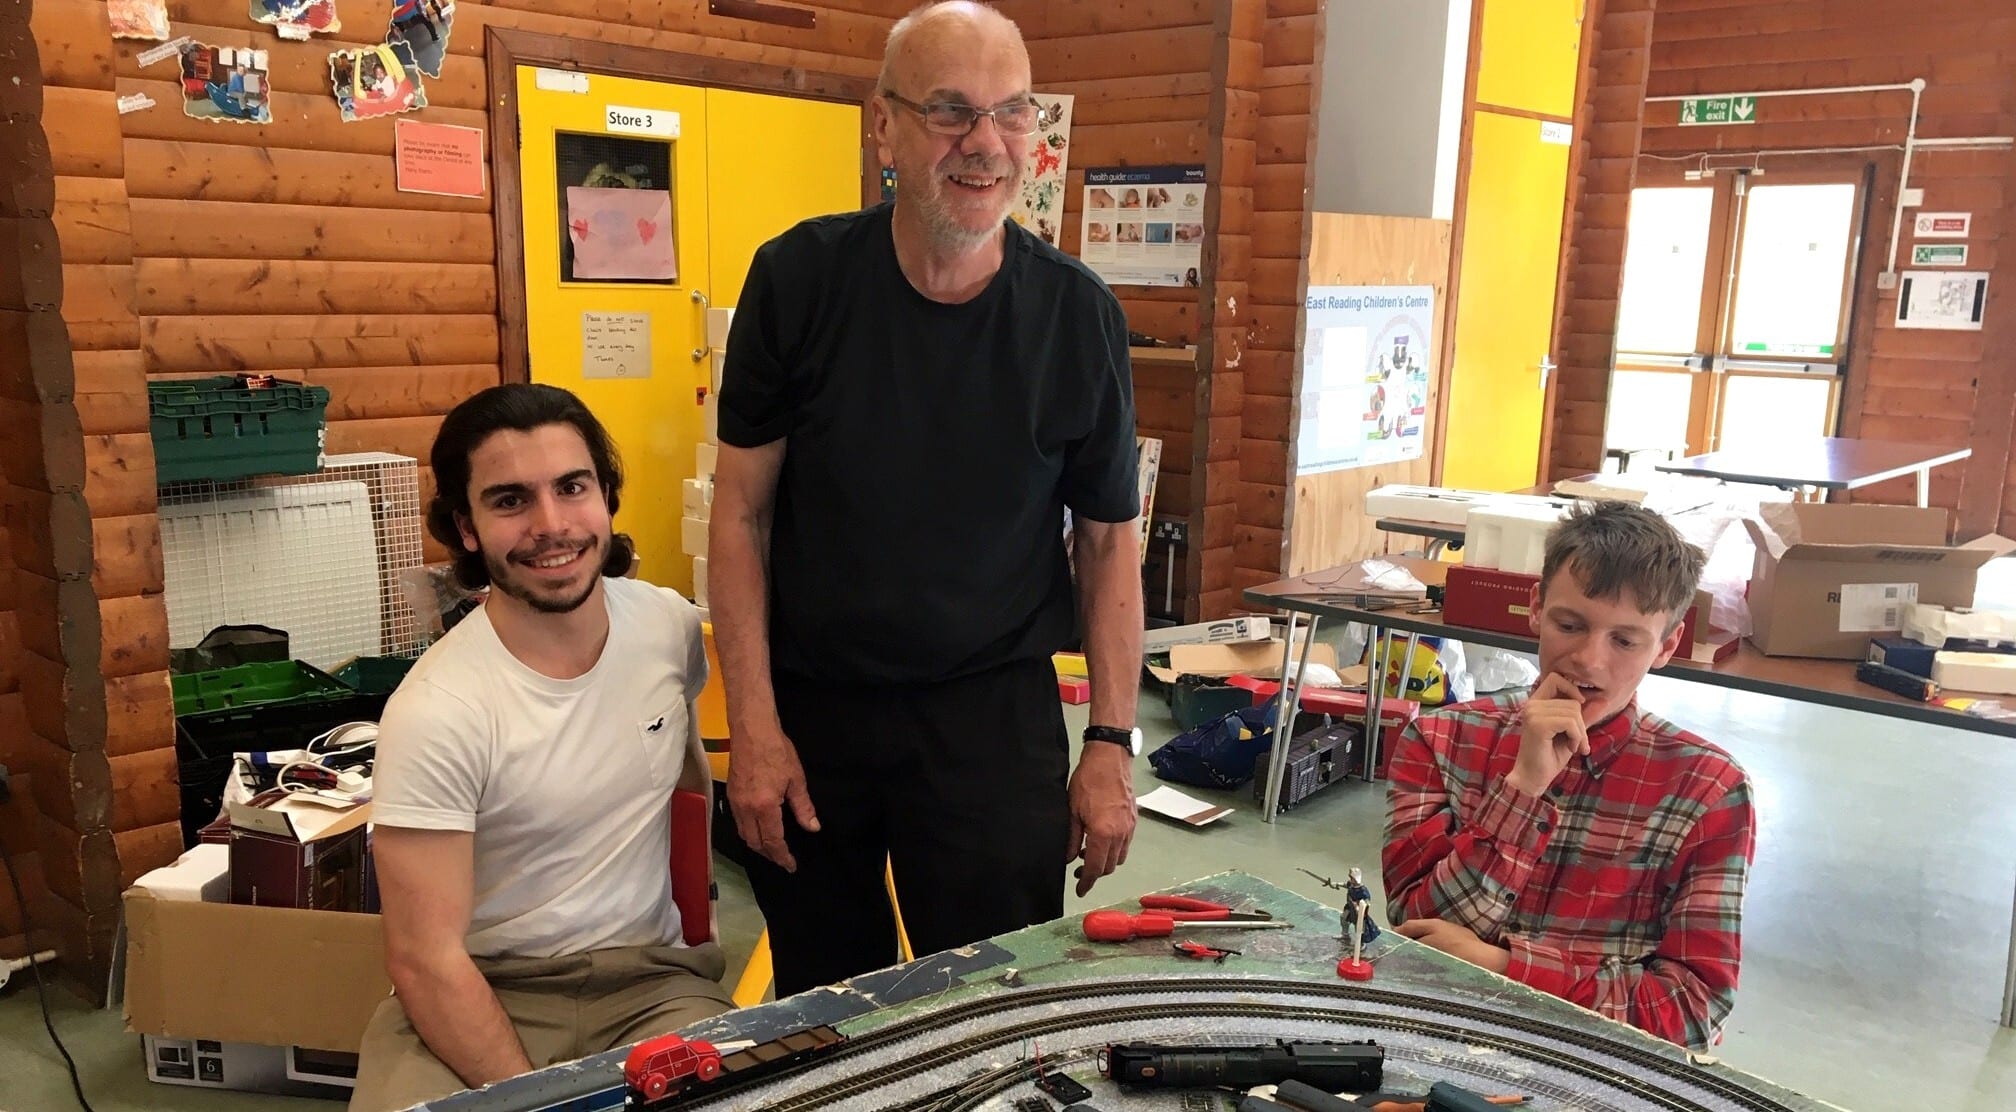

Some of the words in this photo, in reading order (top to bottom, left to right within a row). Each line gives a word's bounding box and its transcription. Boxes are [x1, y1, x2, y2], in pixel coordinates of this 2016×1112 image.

[1706, 101, 1728, 110] Fire
[608, 111, 642, 127] Store
[645, 115, 653, 128] 3
[1705, 111, 1725, 120] exit
[1089, 173, 1108, 181] health
[1306, 296, 1327, 310] East
[1328, 295, 1362, 312] Reading
[1363, 295, 1404, 309] Children's
[1405, 295, 1429, 308] Centre
[206, 1060, 215, 1073] 6
